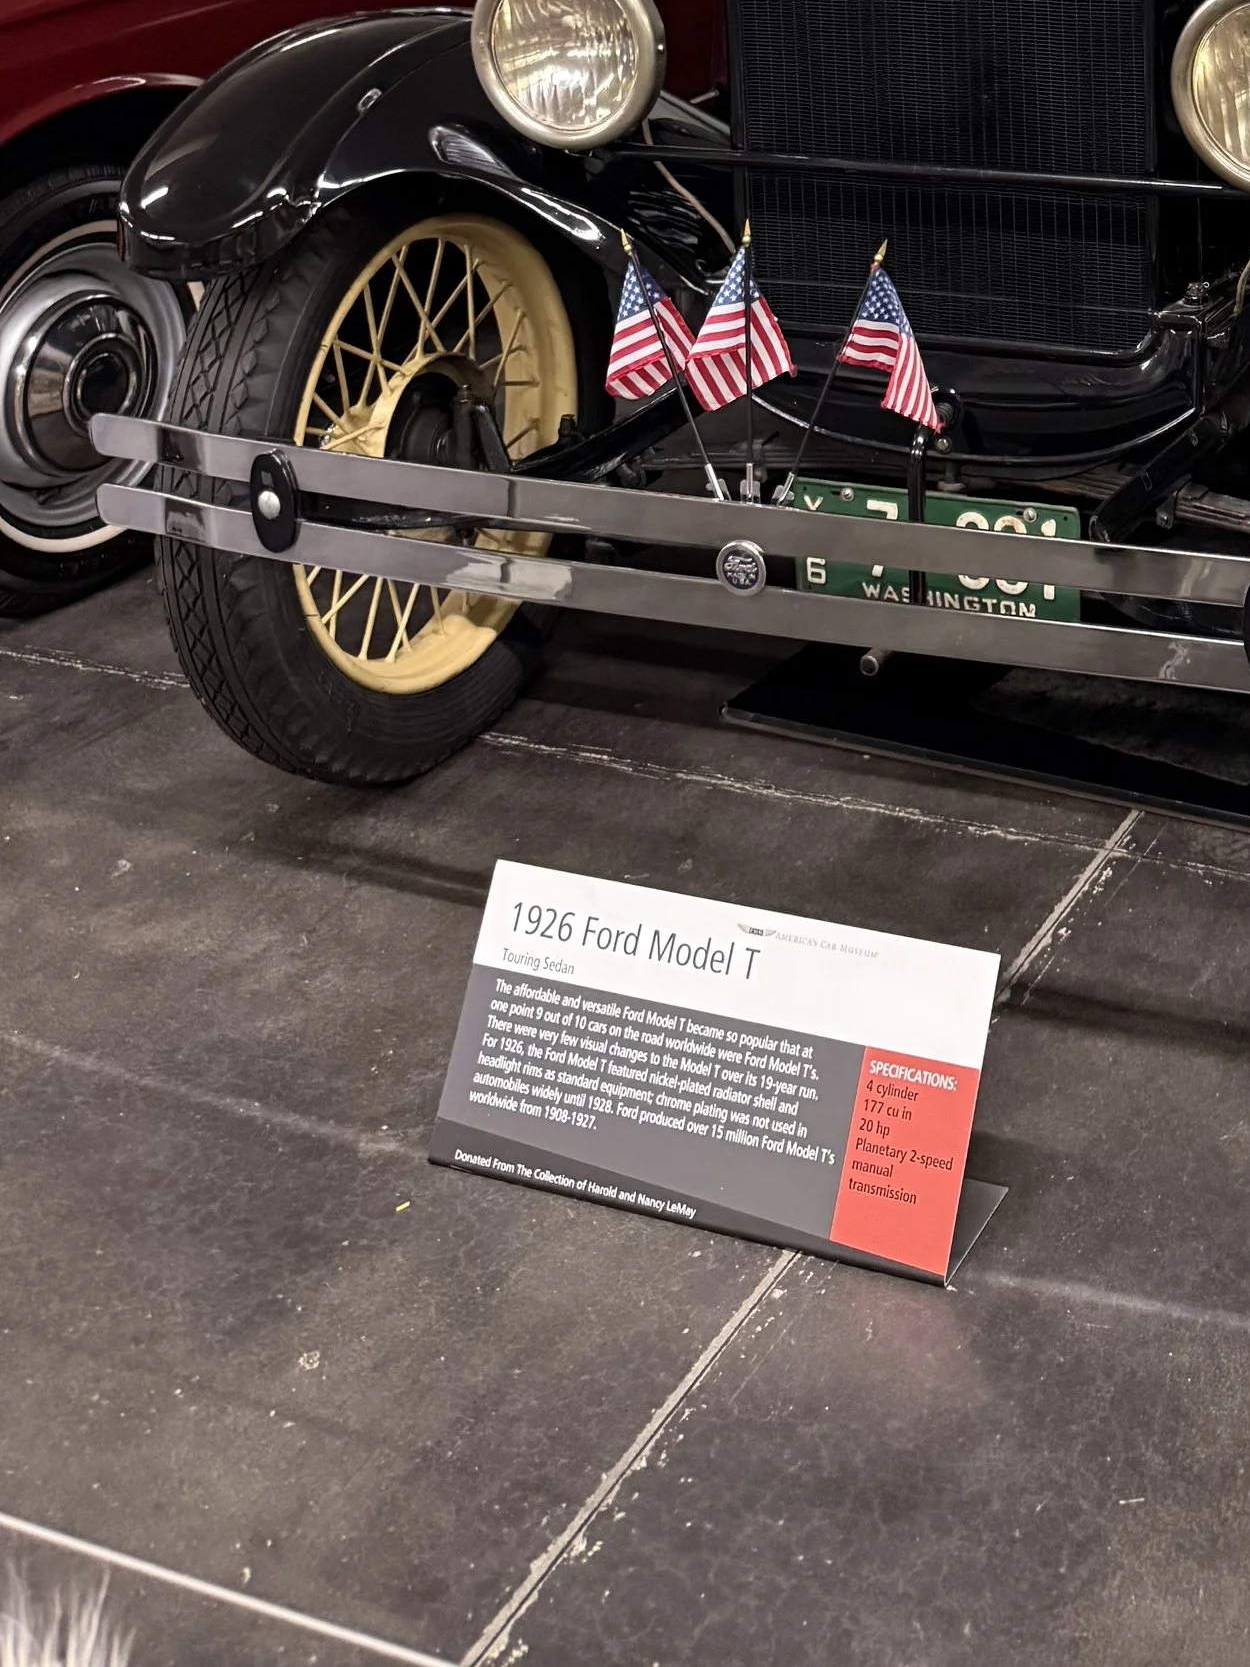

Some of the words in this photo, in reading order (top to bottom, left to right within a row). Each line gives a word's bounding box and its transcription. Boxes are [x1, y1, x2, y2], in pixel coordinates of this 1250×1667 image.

[806, 556, 827, 584] 6
[513, 901, 576, 942] 1926
[581, 915, 643, 957] Ford
[648, 929, 735, 976] Model
[745, 947, 761, 980] T
[502, 947, 541, 972] Touring
[542, 956, 575, 975] Sedan
[495, 978, 513, 995] The
[512, 982, 561, 1005] affordable
[561, 994, 582, 1010] and
[582, 999, 622, 1018] versatile
[622, 1005, 646, 1023] Ford
[645, 1010, 678, 1031] Model
[679, 1017, 687, 1032] T
[686, 1018, 725, 1041] became
[725, 1030, 738, 1044] so
[738, 1033, 779, 1052] popular
[779, 1039, 801, 1057] that
[801, 1046, 814, 1060] at
[490, 999, 509, 1013] one
[508, 1002, 535, 1019] point
[535, 1006, 544, 1021] 9
[543, 1011, 562, 1025] out
[561, 1012, 575, 1027] of
[574, 1014, 587, 1030] 10
[587, 1020, 608, 1035] cars
[608, 1025, 623, 1038] on
[623, 1025, 640, 1042] the
[640, 1031, 665, 1047] road
[665, 1037, 717, 1058] worldwide
[717, 1048, 743, 1064] were
[743, 1051, 768, 1069] Ford
[768, 1055, 802, 1077] Model
[481, 1032, 499, 1049] For
[500, 1036, 525, 1057] 1926,
[527, 1042, 544, 1059] the
[544, 1046, 567, 1064] Ford
[566, 1051, 599, 1071] Model
[600, 1058, 608, 1073] T
[607, 1059, 649, 1083] featured
[648, 1070, 712, 1097] nickel-plated
[712, 1085, 753, 1106] radiator
[752, 1093, 778, 1112] shell
[777, 1100, 800, 1116] and
[487, 1014, 513, 1033] There
[513, 1023, 538, 1039] were
[539, 1028, 560, 1046] very
[559, 1029, 580, 1047] few
[580, 1035, 609, 1054] visual
[608, 1041, 649, 1063] changes
[649, 1051, 661, 1066] to
[662, 1053, 679, 1070] the
[679, 1056, 713, 1077] Model
[714, 1063, 722, 1079] T
[721, 1069, 745, 1084] over
[744, 1070, 758, 1087] its
[760, 1074, 799, 1096] 19-year
[798, 1085, 819, 1101] run.
[869, 1059, 958, 1091] SPECIFICATIONS:
[477, 1050, 523, 1074] headlight
[522, 1061, 544, 1079] rims
[543, 1069, 556, 1081] as
[556, 1071, 601, 1091] standard
[599, 1081, 655, 1106] equipment;
[655, 1091, 693, 1112] chrome
[692, 1100, 729, 1123] plating
[730, 1110, 751, 1126] was
[751, 1115, 771, 1130] not
[771, 1119, 797, 1136] used
[796, 1122, 808, 1139] in
[866, 1079, 874, 1092] 4
[876, 1082, 919, 1102] cylinder
[469, 1090, 519, 1112] worldwide
[519, 1098, 543, 1118] from
[544, 1104, 597, 1130] 1908-1927.
[472, 1072, 530, 1095] automobiles
[531, 1084, 563, 1105] widely
[563, 1092, 587, 1108] until
[588, 1095, 614, 1114] 1928.
[615, 1101, 640, 1120] Ford
[638, 1110, 687, 1131] produced
[686, 1121, 710, 1136] over
[711, 1123, 725, 1140] 15
[724, 1128, 760, 1148] million
[760, 1134, 786, 1154] Ford
[785, 1140, 820, 1162] Model
[859, 1117, 874, 1133] 20
[875, 1120, 890, 1139] hp
[864, 1098, 885, 1114] 177
[886, 1106, 900, 1118] cu
[901, 1105, 912, 1121] in
[851, 1160, 894, 1178] manual
[855, 1137, 908, 1164] Planetary
[909, 1149, 954, 1171] 2-speed
[454, 1148, 493, 1168] Donated
[492, 1157, 515, 1174] From
[516, 1163, 533, 1178] The
[533, 1168, 576, 1189] Collection
[575, 1179, 588, 1191] of
[587, 1181, 618, 1199] Harold
[617, 1190, 637, 1203] and
[637, 1192, 666, 1212] Nancy
[665, 1199, 697, 1220] LeMay
[848, 1177, 917, 1205] transmission
